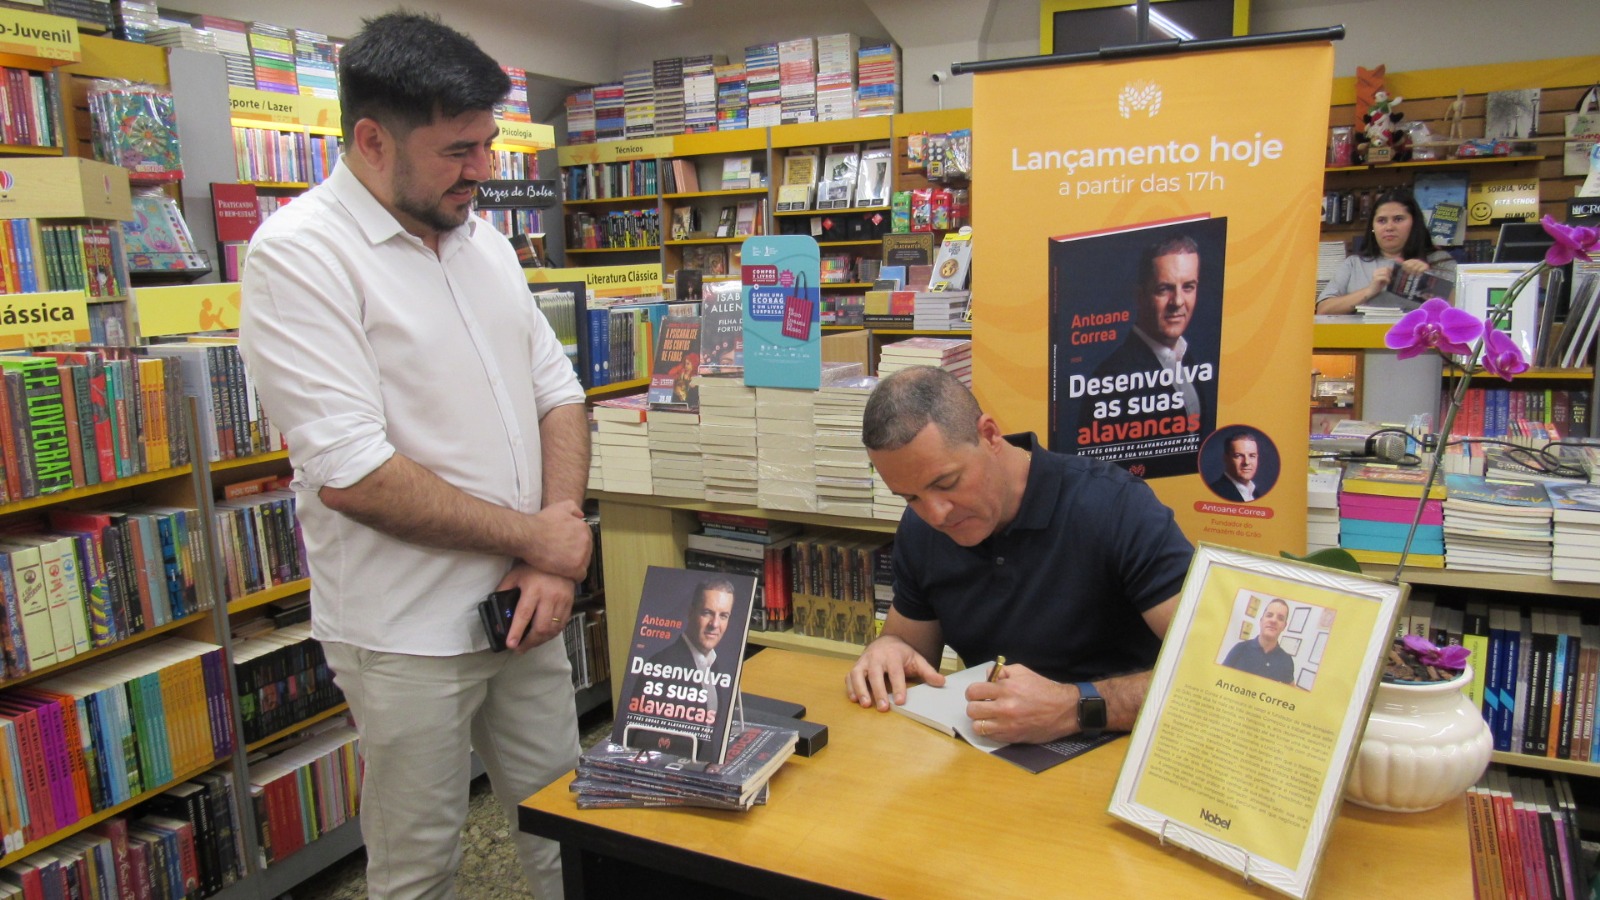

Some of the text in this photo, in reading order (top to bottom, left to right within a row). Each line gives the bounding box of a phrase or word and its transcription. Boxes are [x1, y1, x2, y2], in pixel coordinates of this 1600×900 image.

[267, 101, 292, 112] Lazer
[501, 127, 532, 139] Psicologia
[615, 146, 644, 154] Técnicos
[1011, 133, 1283, 175] Lançamento hoje
[1058, 171, 1224, 199] a partir das 17h
[480, 186, 524, 202] Vozes de
[586, 270, 658, 285] Literatura Clássica
[711, 303, 743, 313] ALLEN
[1071, 310, 1130, 328] Antoane
[665, 328, 669, 339] A
[1071, 329, 1117, 346] Correa
[663, 340, 691, 350] DOS CONTOS
[661, 350, 683, 362] DE FADAS
[22, 360, 60, 390] H.P.
[1069, 361, 1213, 398] Desenvolva
[212, 387, 223, 427] ARIADNE
[221, 386, 232, 426] ARIADNE
[1093, 391, 1185, 419] as suas
[1077, 412, 1200, 445] alavancas
[27, 393, 74, 493] LOVECRAFT
[1136, 439, 1181, 450] ALAVANCAGEM
[1154, 445, 1199, 454] SUSTENTÁVEL
[1202, 503, 1266, 516] Antoane Correa
[1211, 519, 1242, 527] Fundador
[642, 614, 682, 628] Antoane
[640, 626, 671, 640] Correa
[630, 656, 732, 688] Desenvolva
[643, 680, 708, 703] as suas
[1215, 678, 1296, 712] Antoane Correa
[628, 694, 716, 724] alavancas
[667, 722, 702, 731] ALAVANCAGEM
[1199, 807, 1231, 830] Nobel
